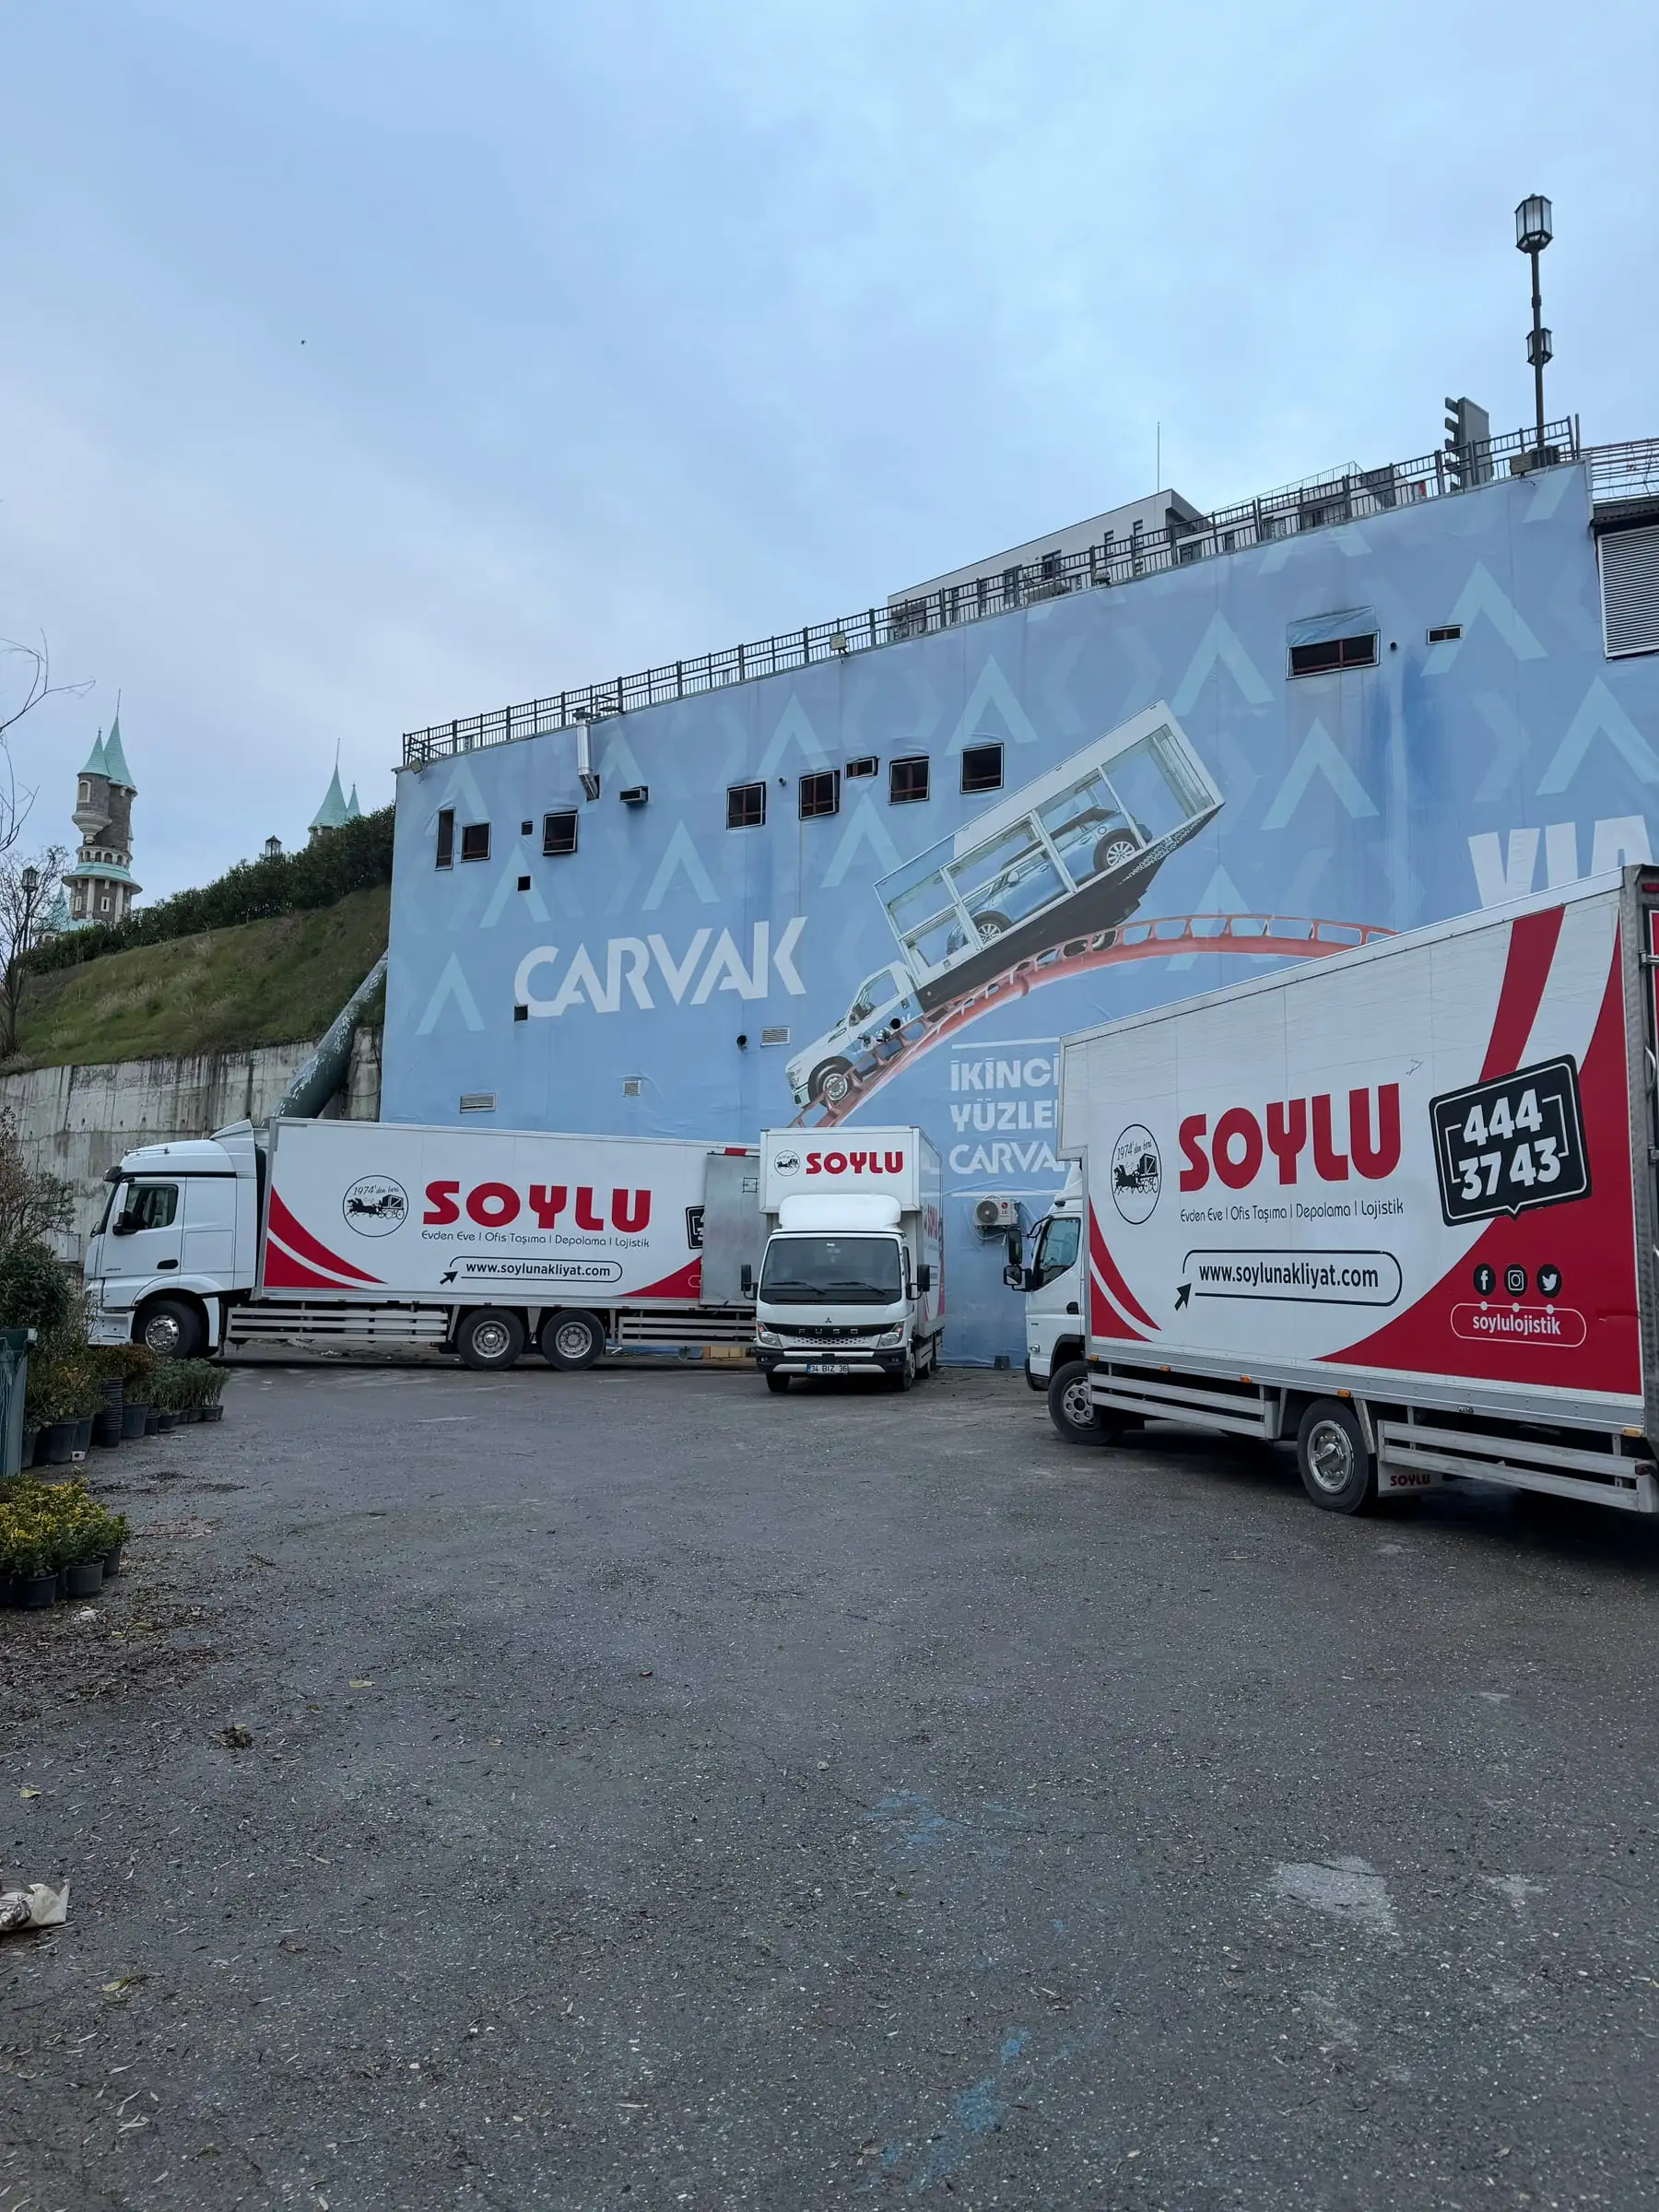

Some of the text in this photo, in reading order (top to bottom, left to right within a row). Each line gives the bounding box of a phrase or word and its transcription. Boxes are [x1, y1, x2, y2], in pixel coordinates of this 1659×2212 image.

[514, 916, 808, 1017] CARVAK
[949, 1098, 1058, 1132] YÜZLE
[1463, 1088, 1543, 1146] 444
[1179, 1083, 1401, 1192] SOYLU
[806, 1151, 903, 1174] SOYLU
[422, 1181, 652, 1232] SOYLU
[1181, 1208, 1206, 1222] Evden
[1207, 1207, 1223, 1221] Eve
[1230, 1206, 1250, 1220] Ofis
[1253, 1205, 1288, 1223] Taşıma
[1296, 1202, 1350, 1221] Depolama
[1361, 1198, 1404, 1219] Lojistik
[421, 1230, 453, 1241] Evden
[457, 1231, 476, 1241] Eve
[485, 1231, 507, 1242] Ofis
[510, 1233, 546, 1244] Taşıma
[555, 1235, 606, 1246] Depolama
[615, 1237, 650, 1249] Lojistik
[466, 1262, 610, 1277] www.soylunakliyat.com
[1199, 1262, 1379, 1289] www.soylunakliyat.com
[1473, 1313, 1561, 1335] soylulojistik
[1390, 1474, 1430, 1487] SOYLU
